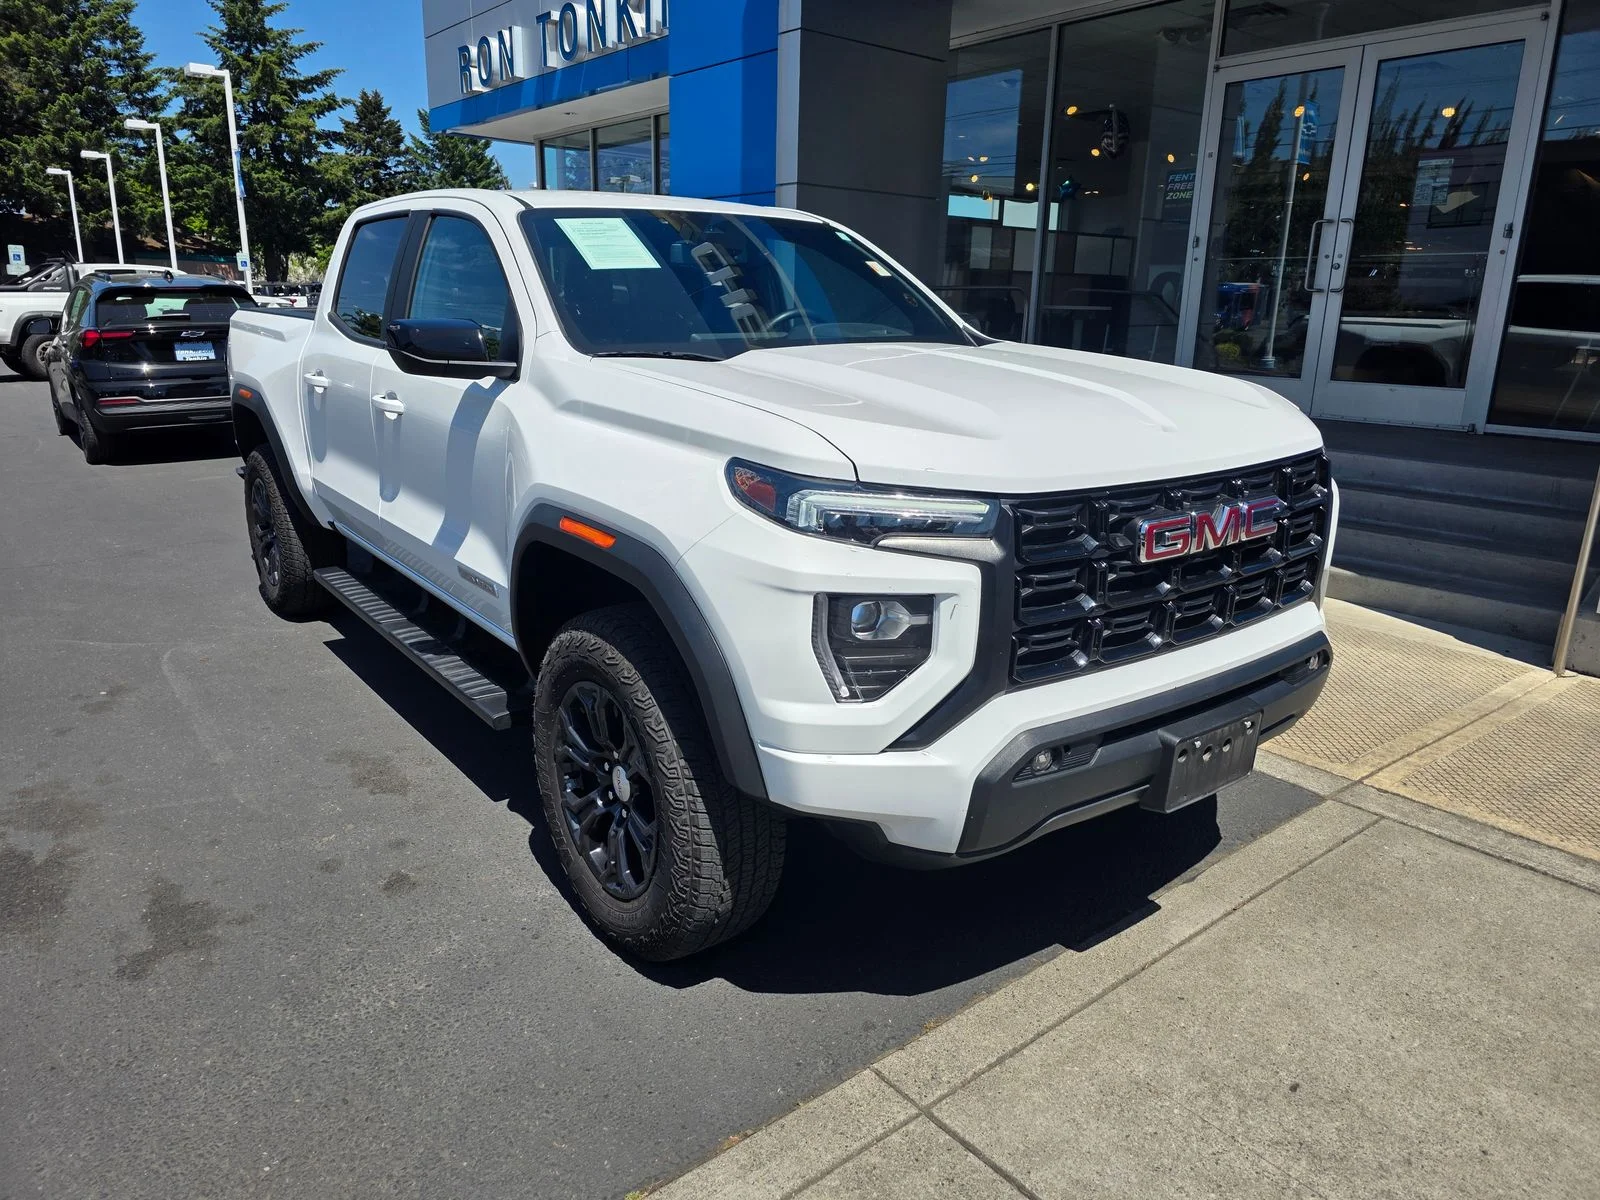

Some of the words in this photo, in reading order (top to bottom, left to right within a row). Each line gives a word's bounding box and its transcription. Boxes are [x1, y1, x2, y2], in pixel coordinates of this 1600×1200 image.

[458, 25, 524, 94] RON
[536, 0, 669, 68] TONKI
[1168, 172, 1196, 182] FENT
[1167, 182, 1195, 191] FREE
[1166, 191, 1193, 200] ZONE
[1139, 496, 1287, 563] GMC
